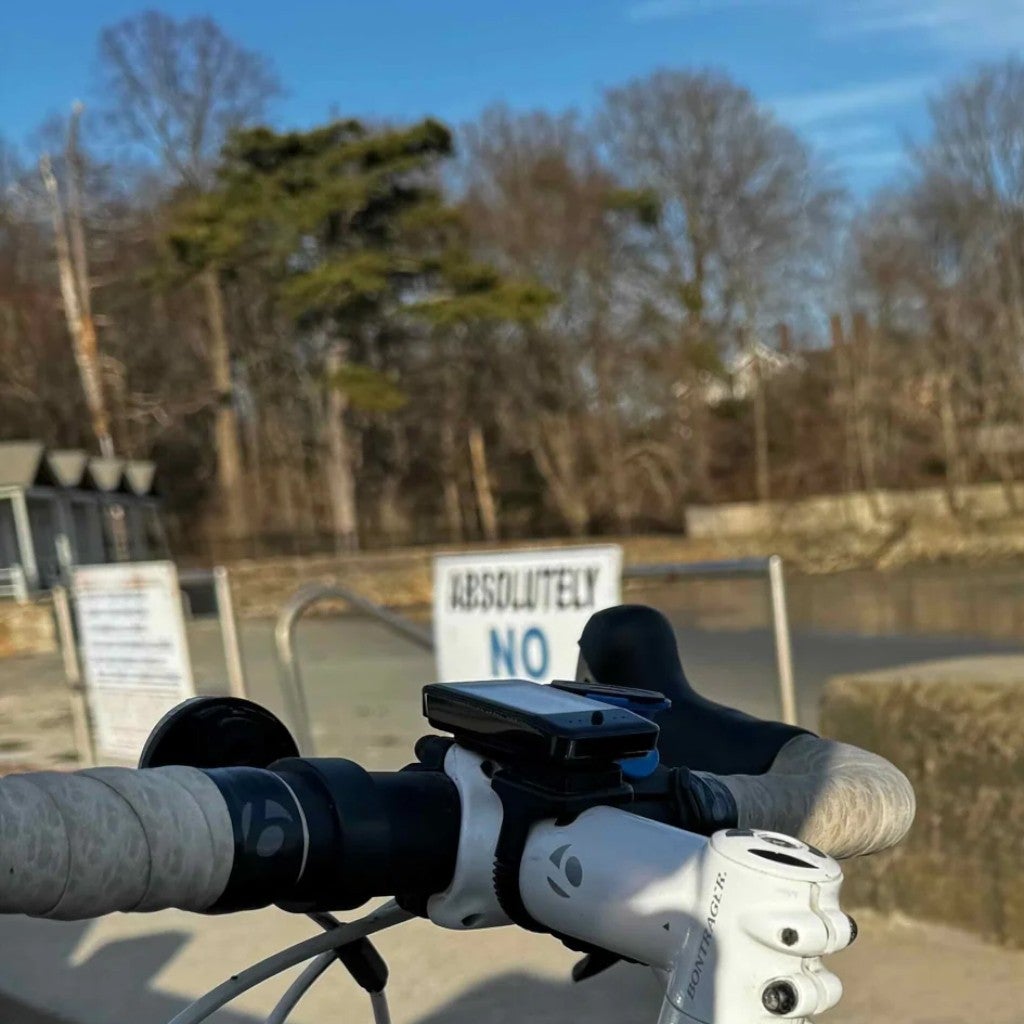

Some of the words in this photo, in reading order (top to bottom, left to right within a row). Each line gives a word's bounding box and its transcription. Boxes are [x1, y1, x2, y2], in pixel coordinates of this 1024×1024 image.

[451, 567, 600, 611] ABSOLUTELY
[490, 626, 549, 678] NO
[687, 872, 726, 1000] BONTRAGER
